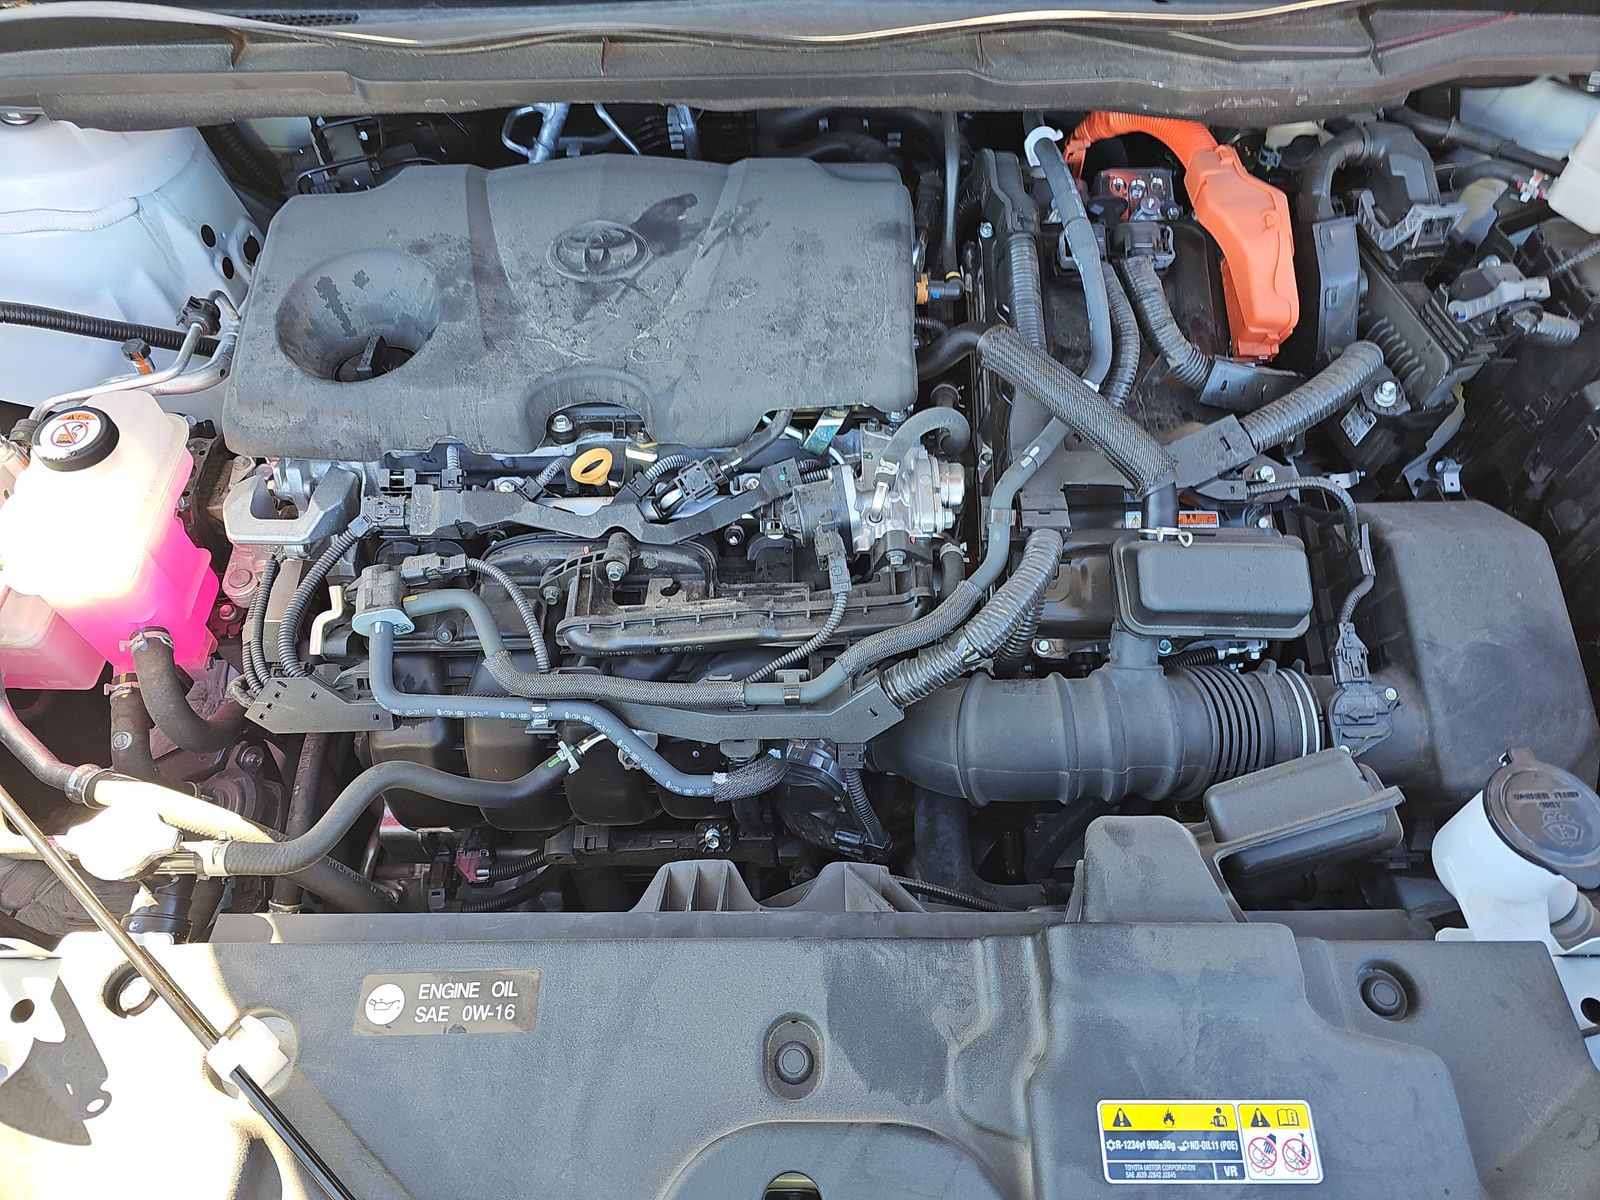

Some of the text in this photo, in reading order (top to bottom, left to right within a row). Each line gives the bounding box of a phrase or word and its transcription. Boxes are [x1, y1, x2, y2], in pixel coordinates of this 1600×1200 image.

[418, 981, 519, 1000] ENGINE OIL
[414, 1004, 516, 1023] SAE 0W-16
[1220, 1140, 1239, 1152] (POE)
[1125, 1171, 1136, 1179] SAE
[1223, 1165, 1239, 1177] VR
